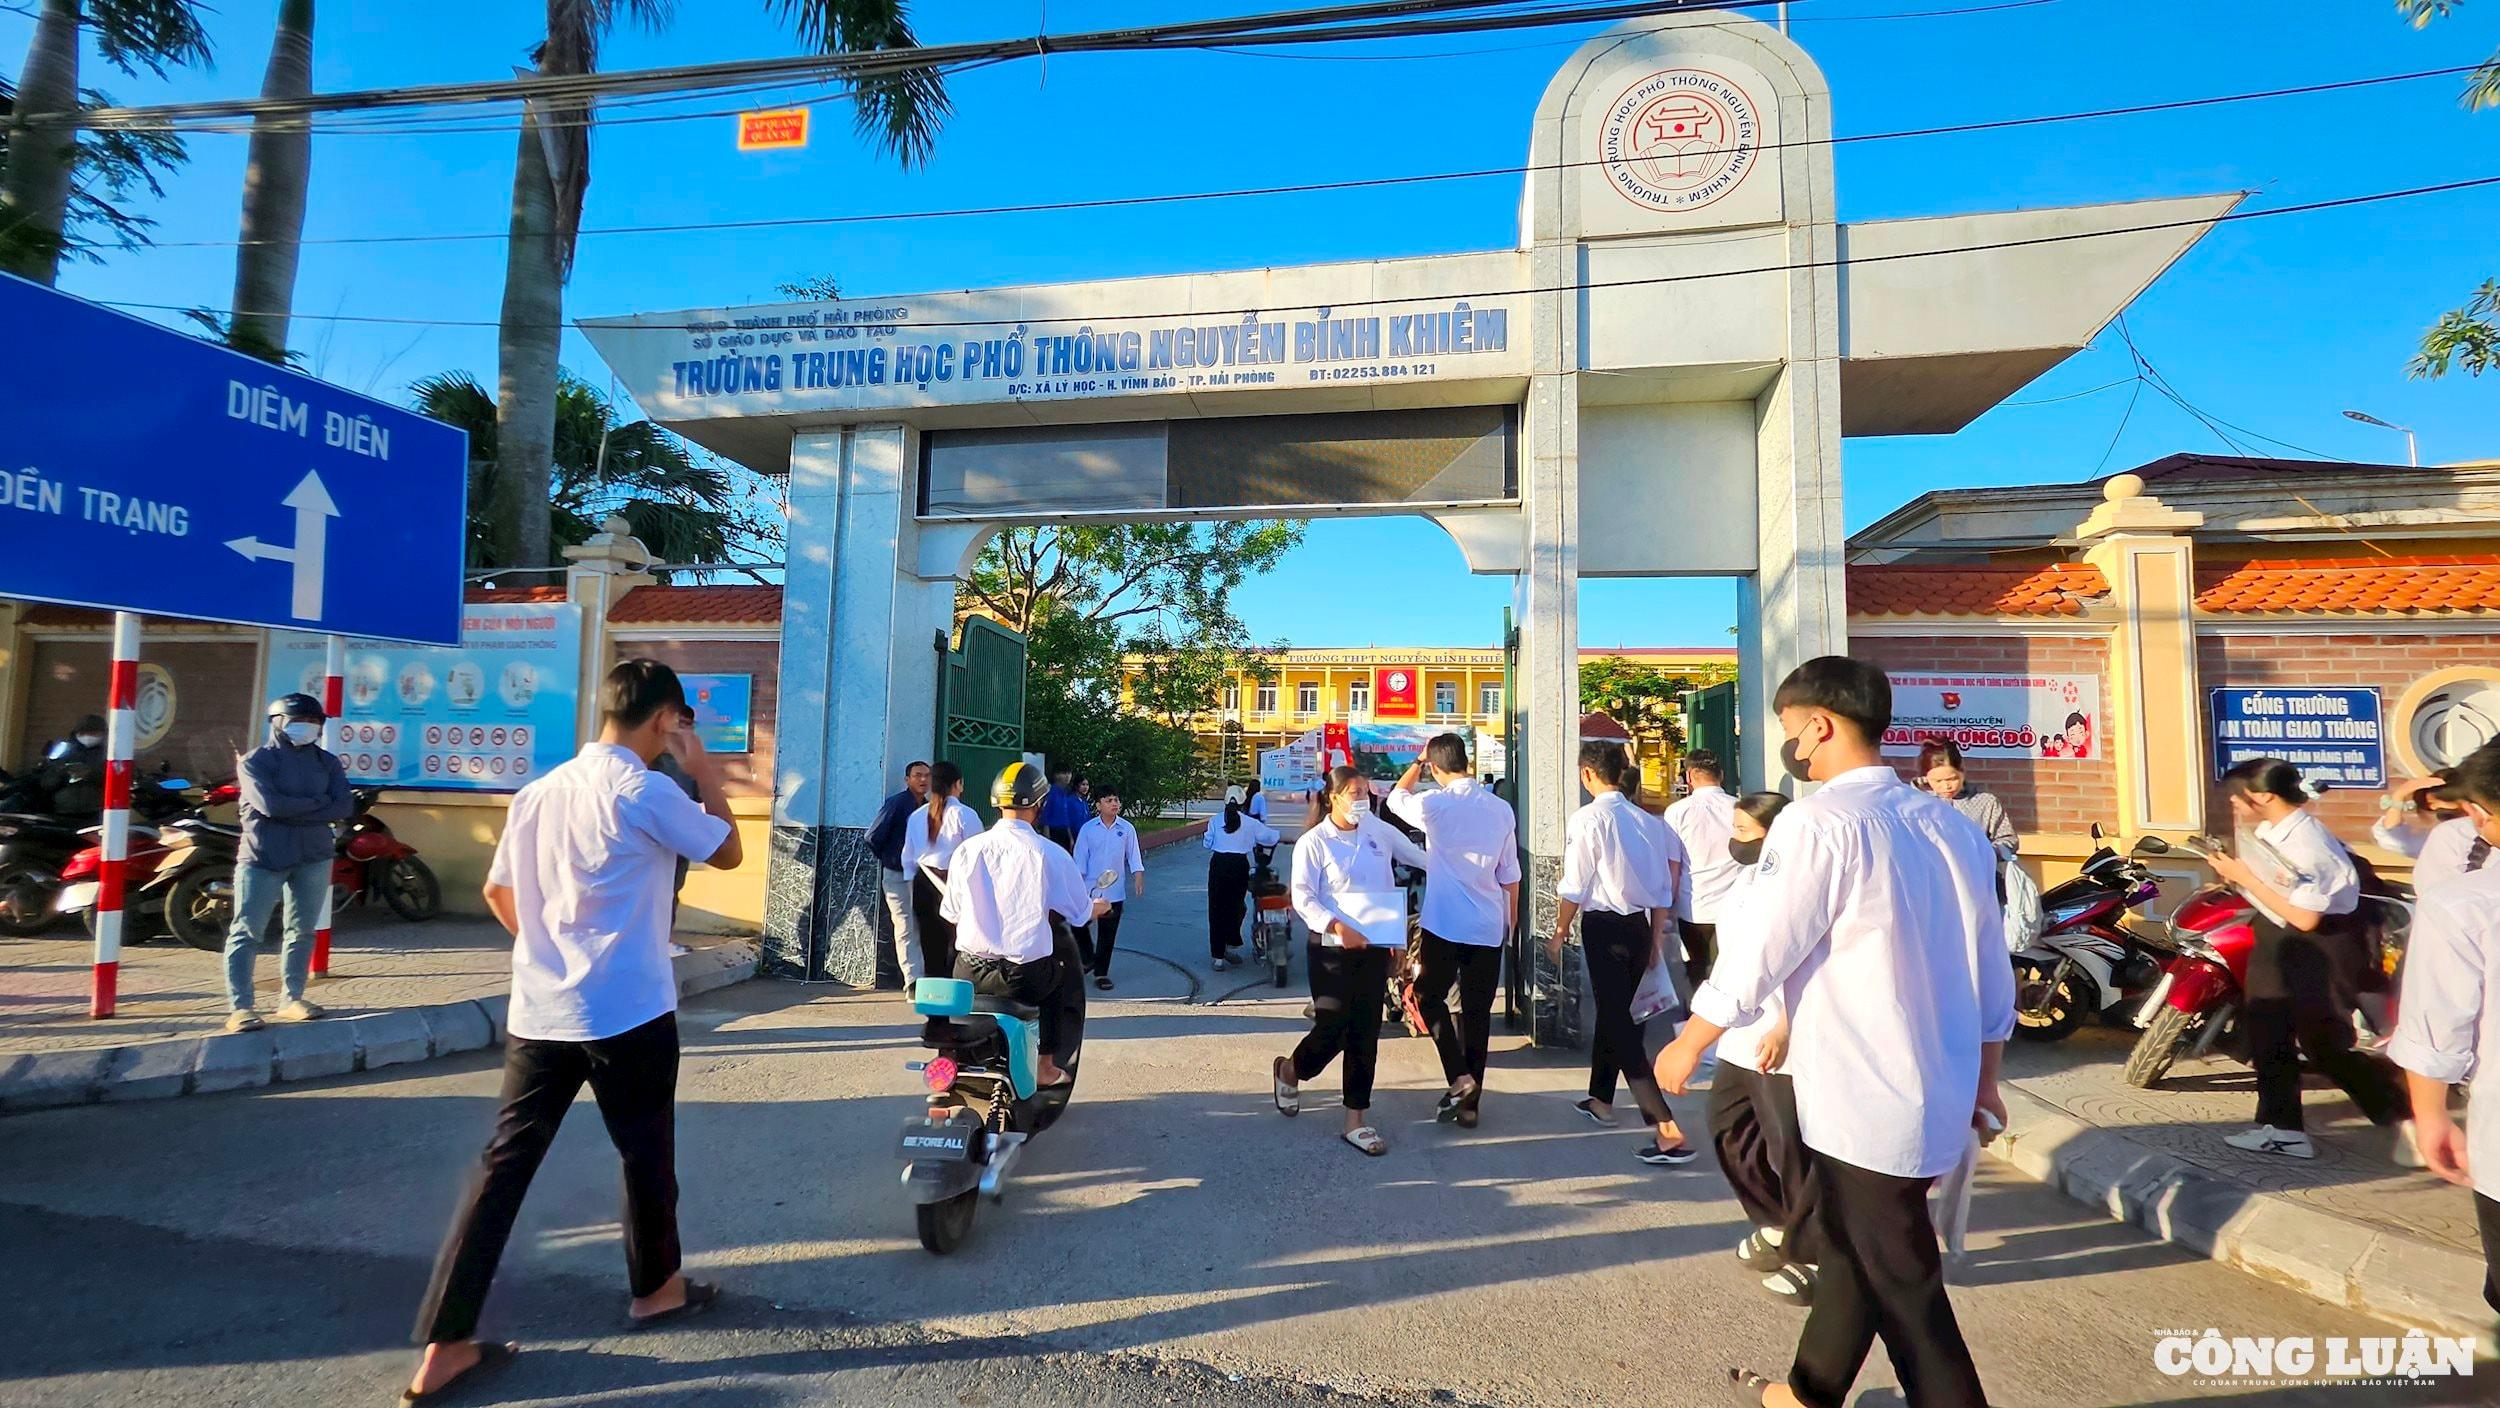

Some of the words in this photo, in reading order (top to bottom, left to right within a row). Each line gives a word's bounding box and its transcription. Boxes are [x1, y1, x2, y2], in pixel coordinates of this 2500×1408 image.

[1670, 74, 1719, 92] THÔNG
[1615, 98, 1637, 124] HỌC
[1608, 127, 1622, 172] TRUNG
[1688, 174, 1731, 202] KHIÊM
[853, 307, 908, 323] PHÒNG
[672, 348, 784, 400] TRƯỜNG
[791, 345, 888, 392] TRUNG
[893, 343, 955, 393] HỌC
[962, 324, 1028, 382] PHỔ
[1033, 325, 1142, 378] THÔNG
[1147, 308, 1286, 371] NGUYỄN
[1292, 306, 1381, 364] BỈNH
[1388, 302, 1508, 359] KHIÊM
[760, 331, 792, 349] DỤC
[1411, 363, 1436, 376] 121
[1035, 380, 1051, 394] XÃ
[1055, 379, 1069, 393] LÝ
[1073, 381, 1096, 395] HỌC
[1107, 379, 1118, 391] H.
[1121, 376, 1149, 390] VĨNH
[1152, 373, 1177, 388] BẢO
[1188, 375, 1207, 387] TP.
[1209, 370, 1230, 386] HẢI
[1233, 369, 1276, 384] PHÒNG
[227, 379, 309, 438] DIÊM
[0, 466, 62, 515] ĐỀN
[78, 487, 189, 537] TRẠNG
[1342, 654, 1377, 663] THPT
[2241, 691, 2285, 715] CỔNG
[2286, 693, 2349, 716] TRƯỜNG
[1882, 728, 1911, 744] OA
[2003, 724, 2036, 746] ĐỎ
[2218, 719, 2240, 738] AN
[2242, 717, 2284, 738] TOÀN
[2285, 720, 2323, 739] GIAO
[2325, 717, 2377, 740] THÔNG
[903, 1136, 945, 1148] BEFORE
[944, 1138, 963, 1149] ALL
